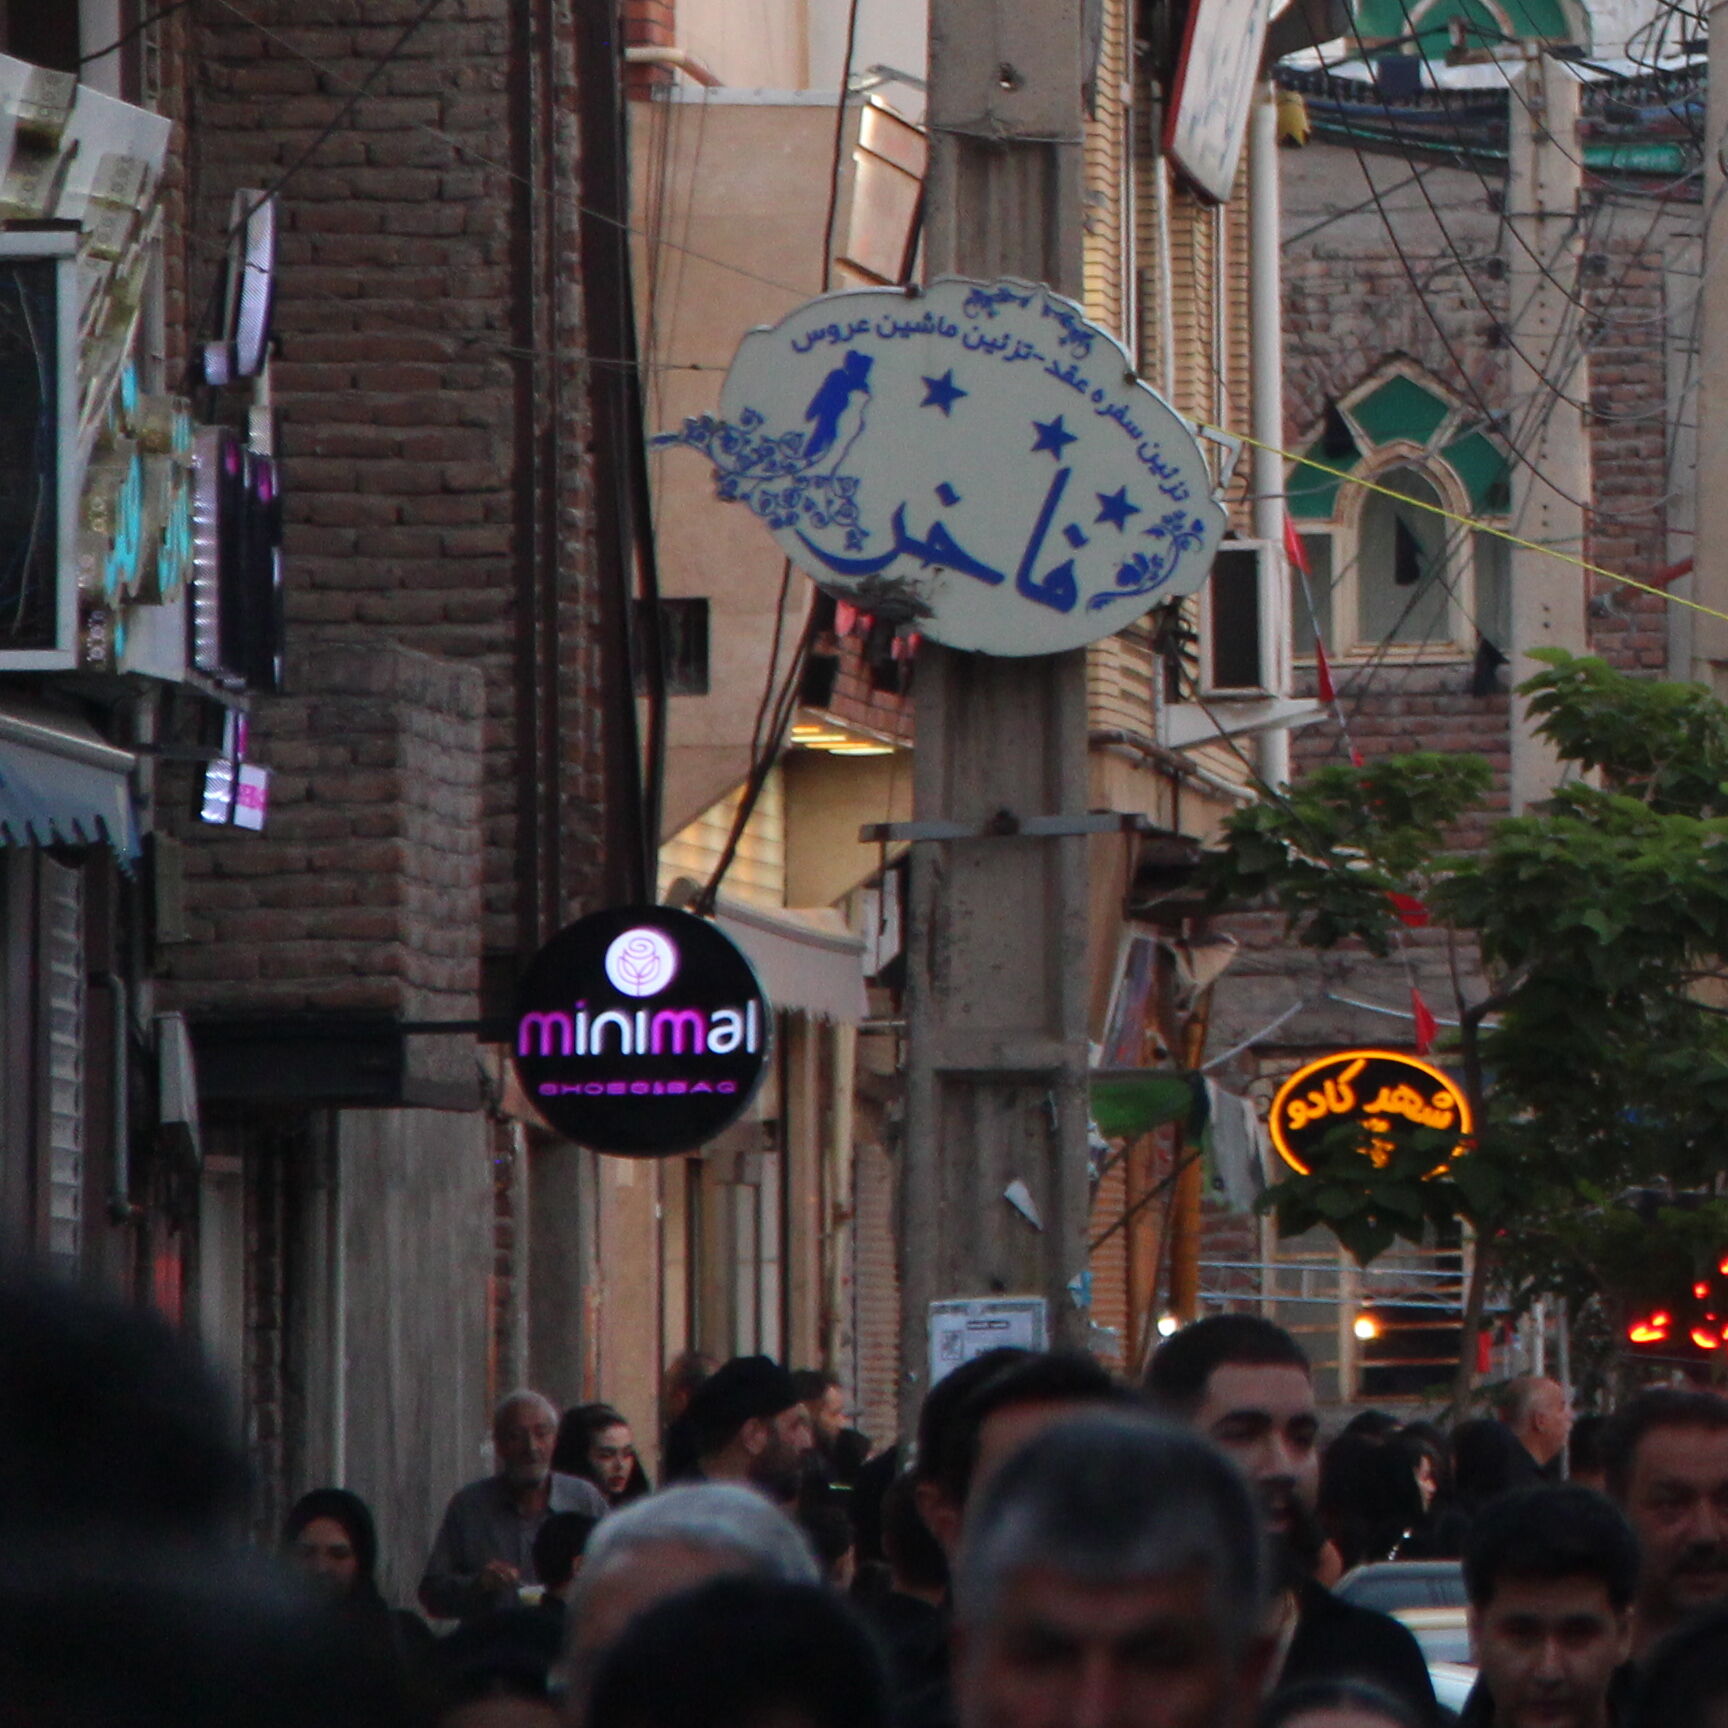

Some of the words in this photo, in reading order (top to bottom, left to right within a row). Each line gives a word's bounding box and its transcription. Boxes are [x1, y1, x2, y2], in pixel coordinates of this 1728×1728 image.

[791, 317, 869, 353] عروس
[876, 312, 957, 339] ماشین
[1090, 388, 1143, 440] سفره
[1138, 439, 1190, 503] تزئین
[793, 465, 1089, 614] فاخر
[518, 998, 757, 1056] minimal
[1286, 1058, 1368, 1130] کادو
